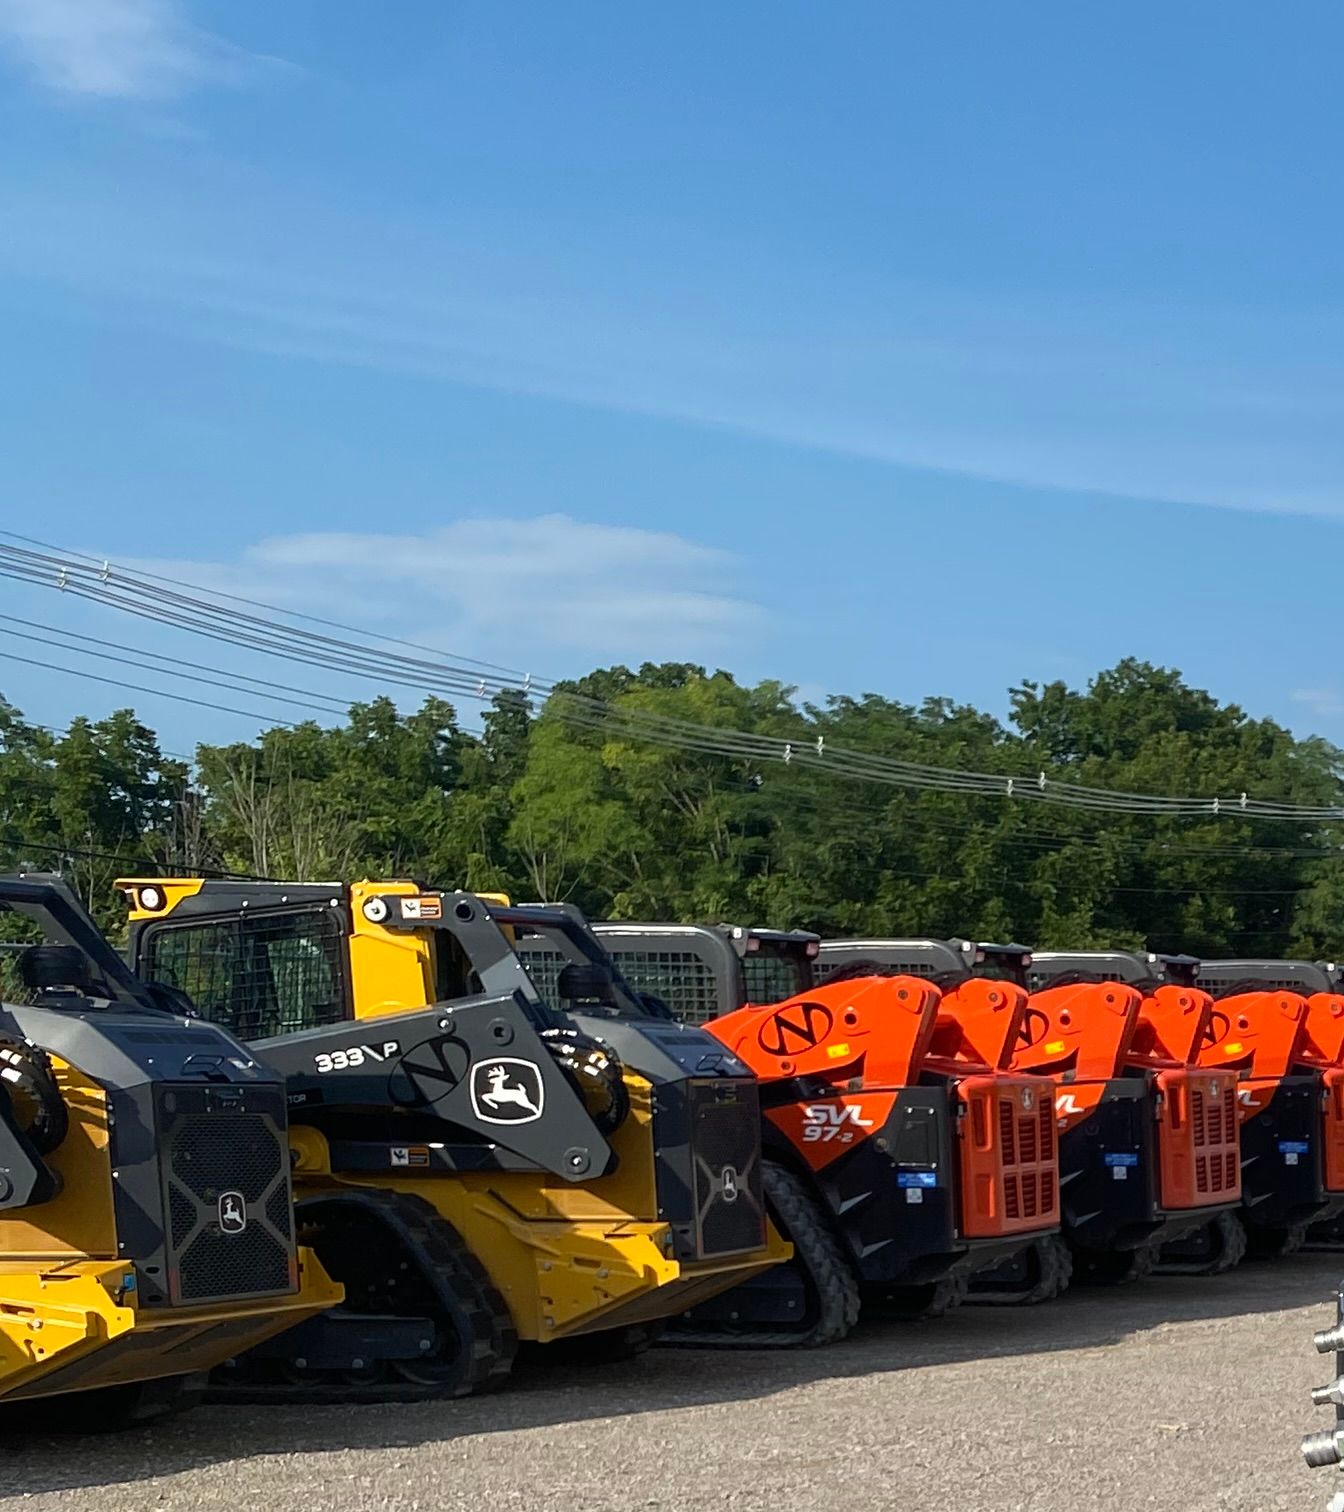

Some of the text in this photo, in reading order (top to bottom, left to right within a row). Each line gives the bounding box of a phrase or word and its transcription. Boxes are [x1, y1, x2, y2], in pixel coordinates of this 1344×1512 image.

[315, 1047, 365, 1073] 333
[803, 1104, 874, 1126] SVL
[803, 1126, 853, 1142] 97-2
